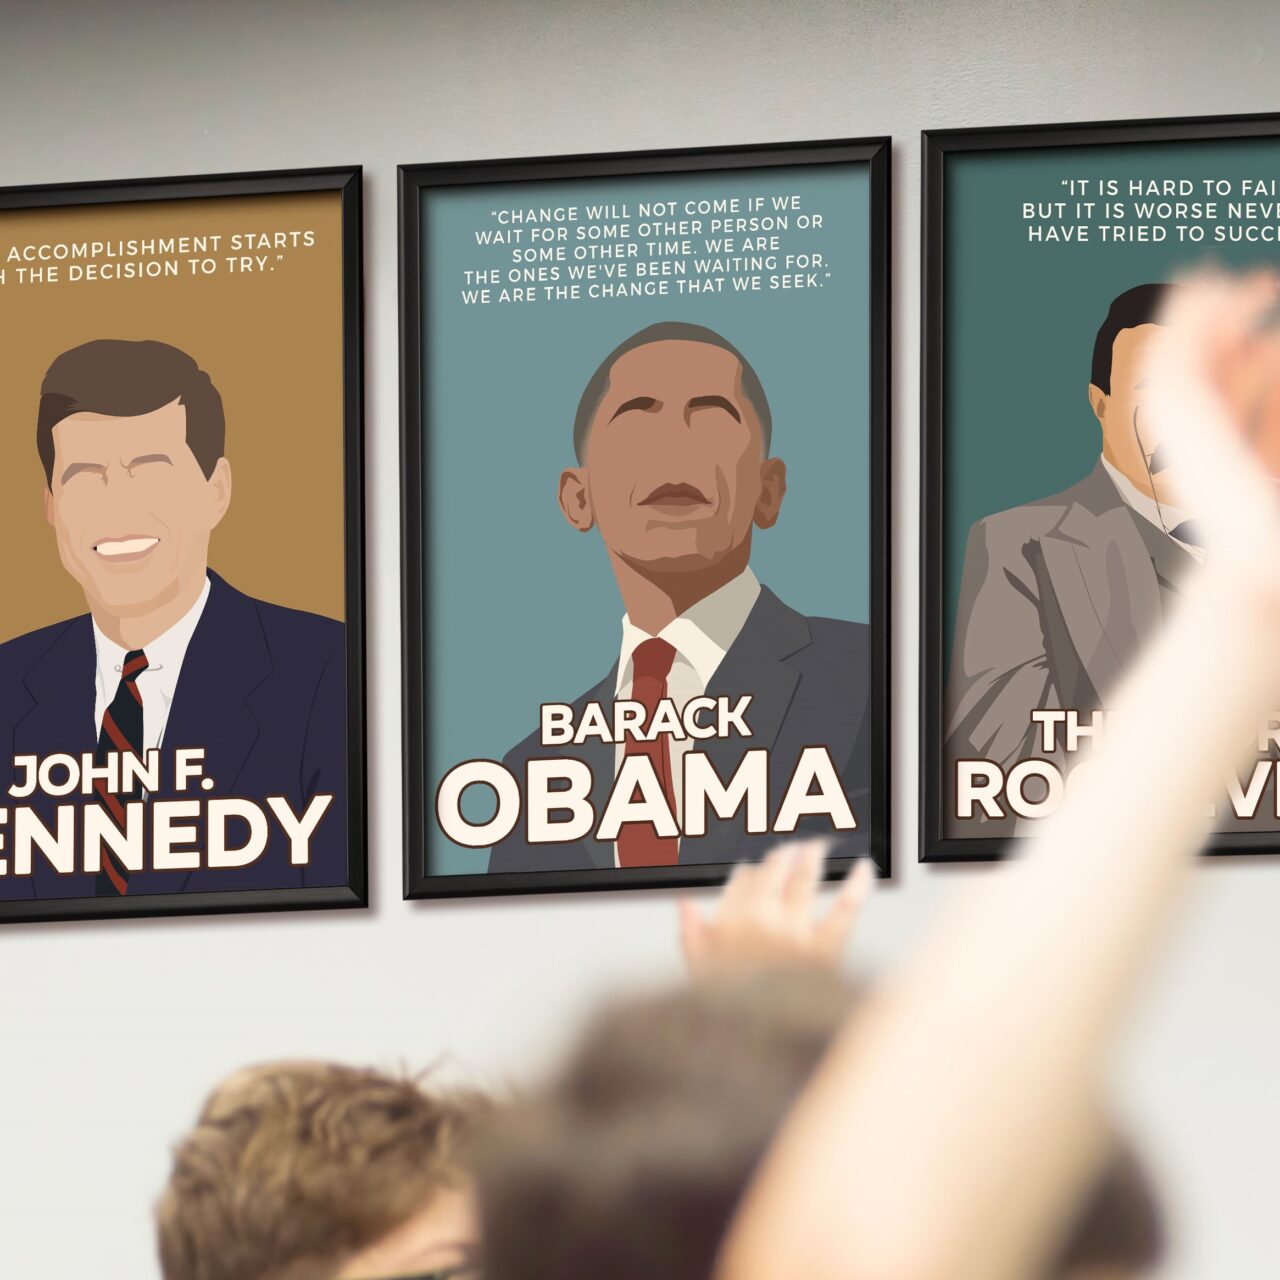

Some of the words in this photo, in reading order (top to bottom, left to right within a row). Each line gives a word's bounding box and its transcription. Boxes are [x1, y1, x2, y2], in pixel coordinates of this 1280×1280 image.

[1099, 179, 1119, 196] IS
[1129, 179, 1194, 196] HARD
[1202, 179, 1232, 196] TO
[585, 204, 631, 220] WILL
[639, 201, 678, 218] NOT
[684, 198, 740, 215] COME
[748, 197, 765, 212] IF
[771, 195, 801, 211] WE
[1022, 202, 1067, 219] BUT
[1076, 202, 1096, 219] IT
[1105, 202, 1125, 219] IS
[1134, 202, 1218, 219] WORSE
[474, 229, 523, 245] WAIT
[531, 227, 568, 243] FOR
[575, 223, 630, 241] SOME
[637, 220, 702, 237] OTHER
[711, 215, 788, 234] PERSON
[796, 214, 823, 229] OR
[1028, 225, 1089, 242] HAVE
[1098, 225, 1167, 242] TRIED
[1175, 225, 1205, 242] TO
[6, 235, 222, 262] ACCOMPLISHMENT
[230, 230, 315, 251] STARTS
[512, 246, 566, 263] SOME
[573, 243, 638, 260] OTHER
[646, 240, 697, 257] TIME.
[704, 238, 734, 254] WE
[741, 235, 780, 252] ARE
[15, 266, 58, 284] THE
[69, 260, 178, 281] DECISION
[187, 258, 217, 275] TO
[463, 269, 501, 285] THE
[508, 266, 560, 283] ONES
[567, 263, 628, 280] WE'VE
[636, 260, 686, 277] BEEN
[693, 255, 777, 274] WAITING
[785, 253, 828, 270] FOR.
[461, 289, 491, 305] WE
[498, 287, 537, 303] ARE
[543, 284, 581, 301] THE
[588, 280, 669, 299] CHANGE
[676, 277, 725, 294] THAT
[732, 275, 761, 291] WE
[540, 694, 754, 746] BARACK
[7, 749, 160, 798] JOHN
[174, 748, 215, 792] F.
[436, 746, 858, 848] OBAMA
[0, 794, 334, 875] NNEDY
